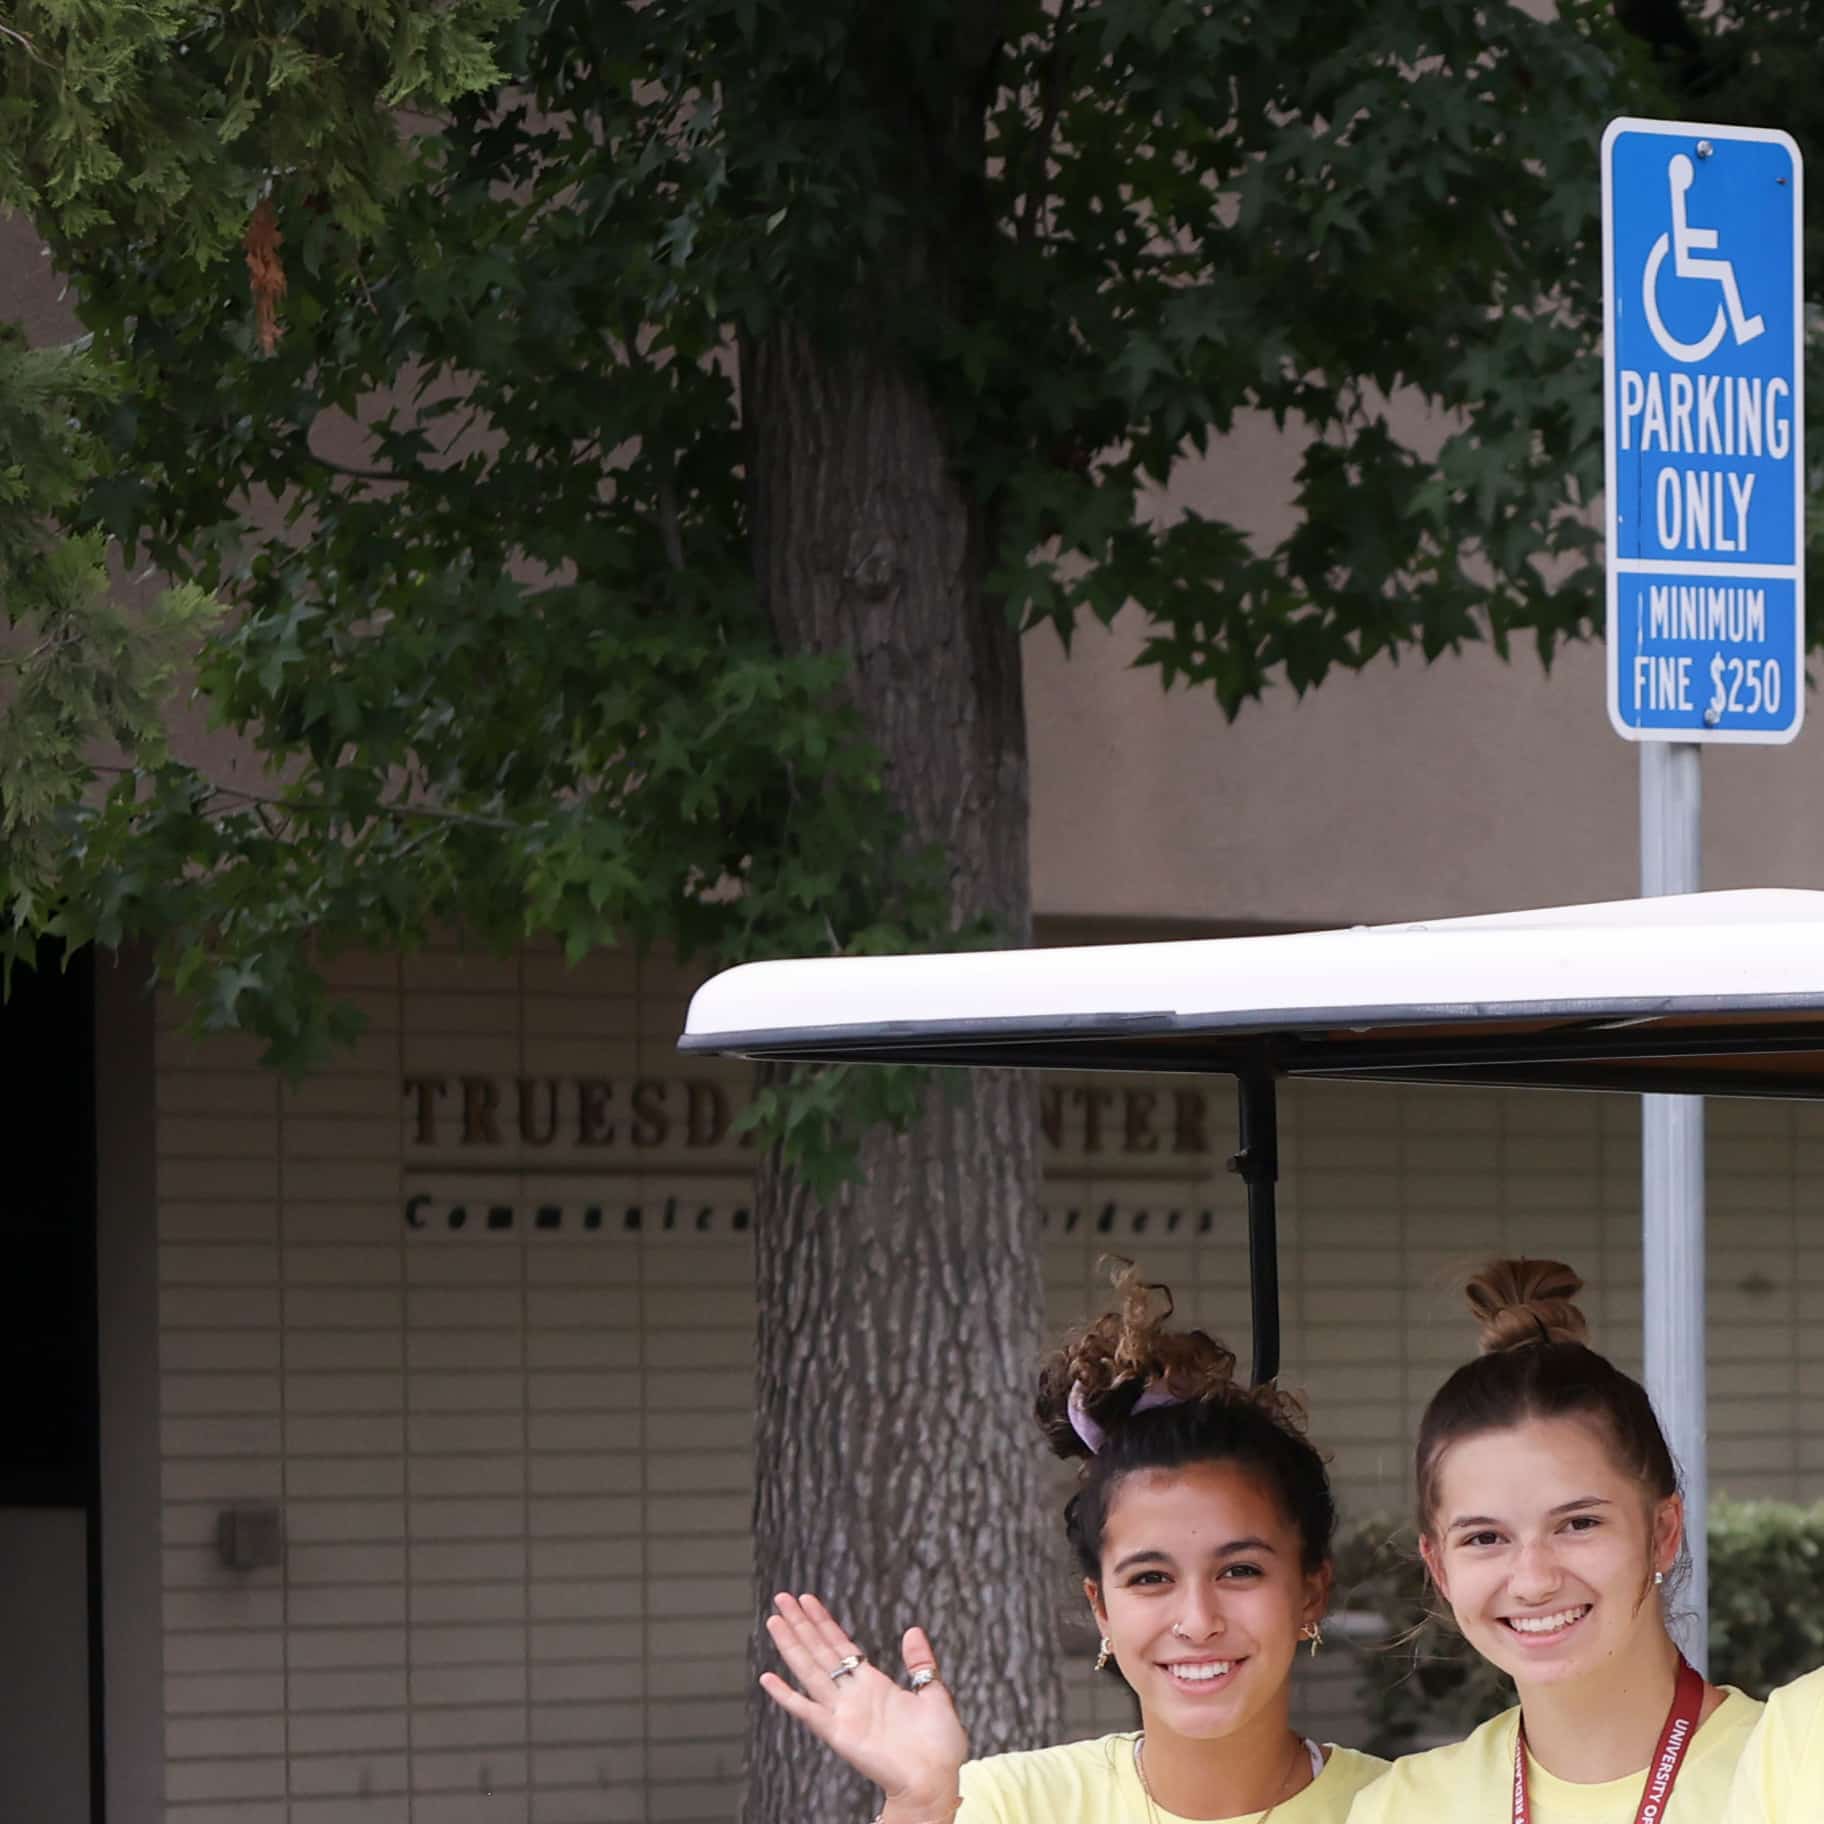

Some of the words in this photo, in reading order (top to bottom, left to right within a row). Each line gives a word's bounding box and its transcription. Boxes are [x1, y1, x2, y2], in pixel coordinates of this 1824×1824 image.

[1620, 370, 1790, 459] PARKING
[1656, 467, 1756, 552] ONLY
[1650, 585, 1766, 643] MINIMUM
[1634, 655, 1692, 710] FINE
[1709, 651, 1781, 714] $250
[403, 1076, 754, 1149] TRUESD
[1040, 1085, 1210, 1154] NTER
[1649, 1718, 1690, 1804] UNIVERSITY
